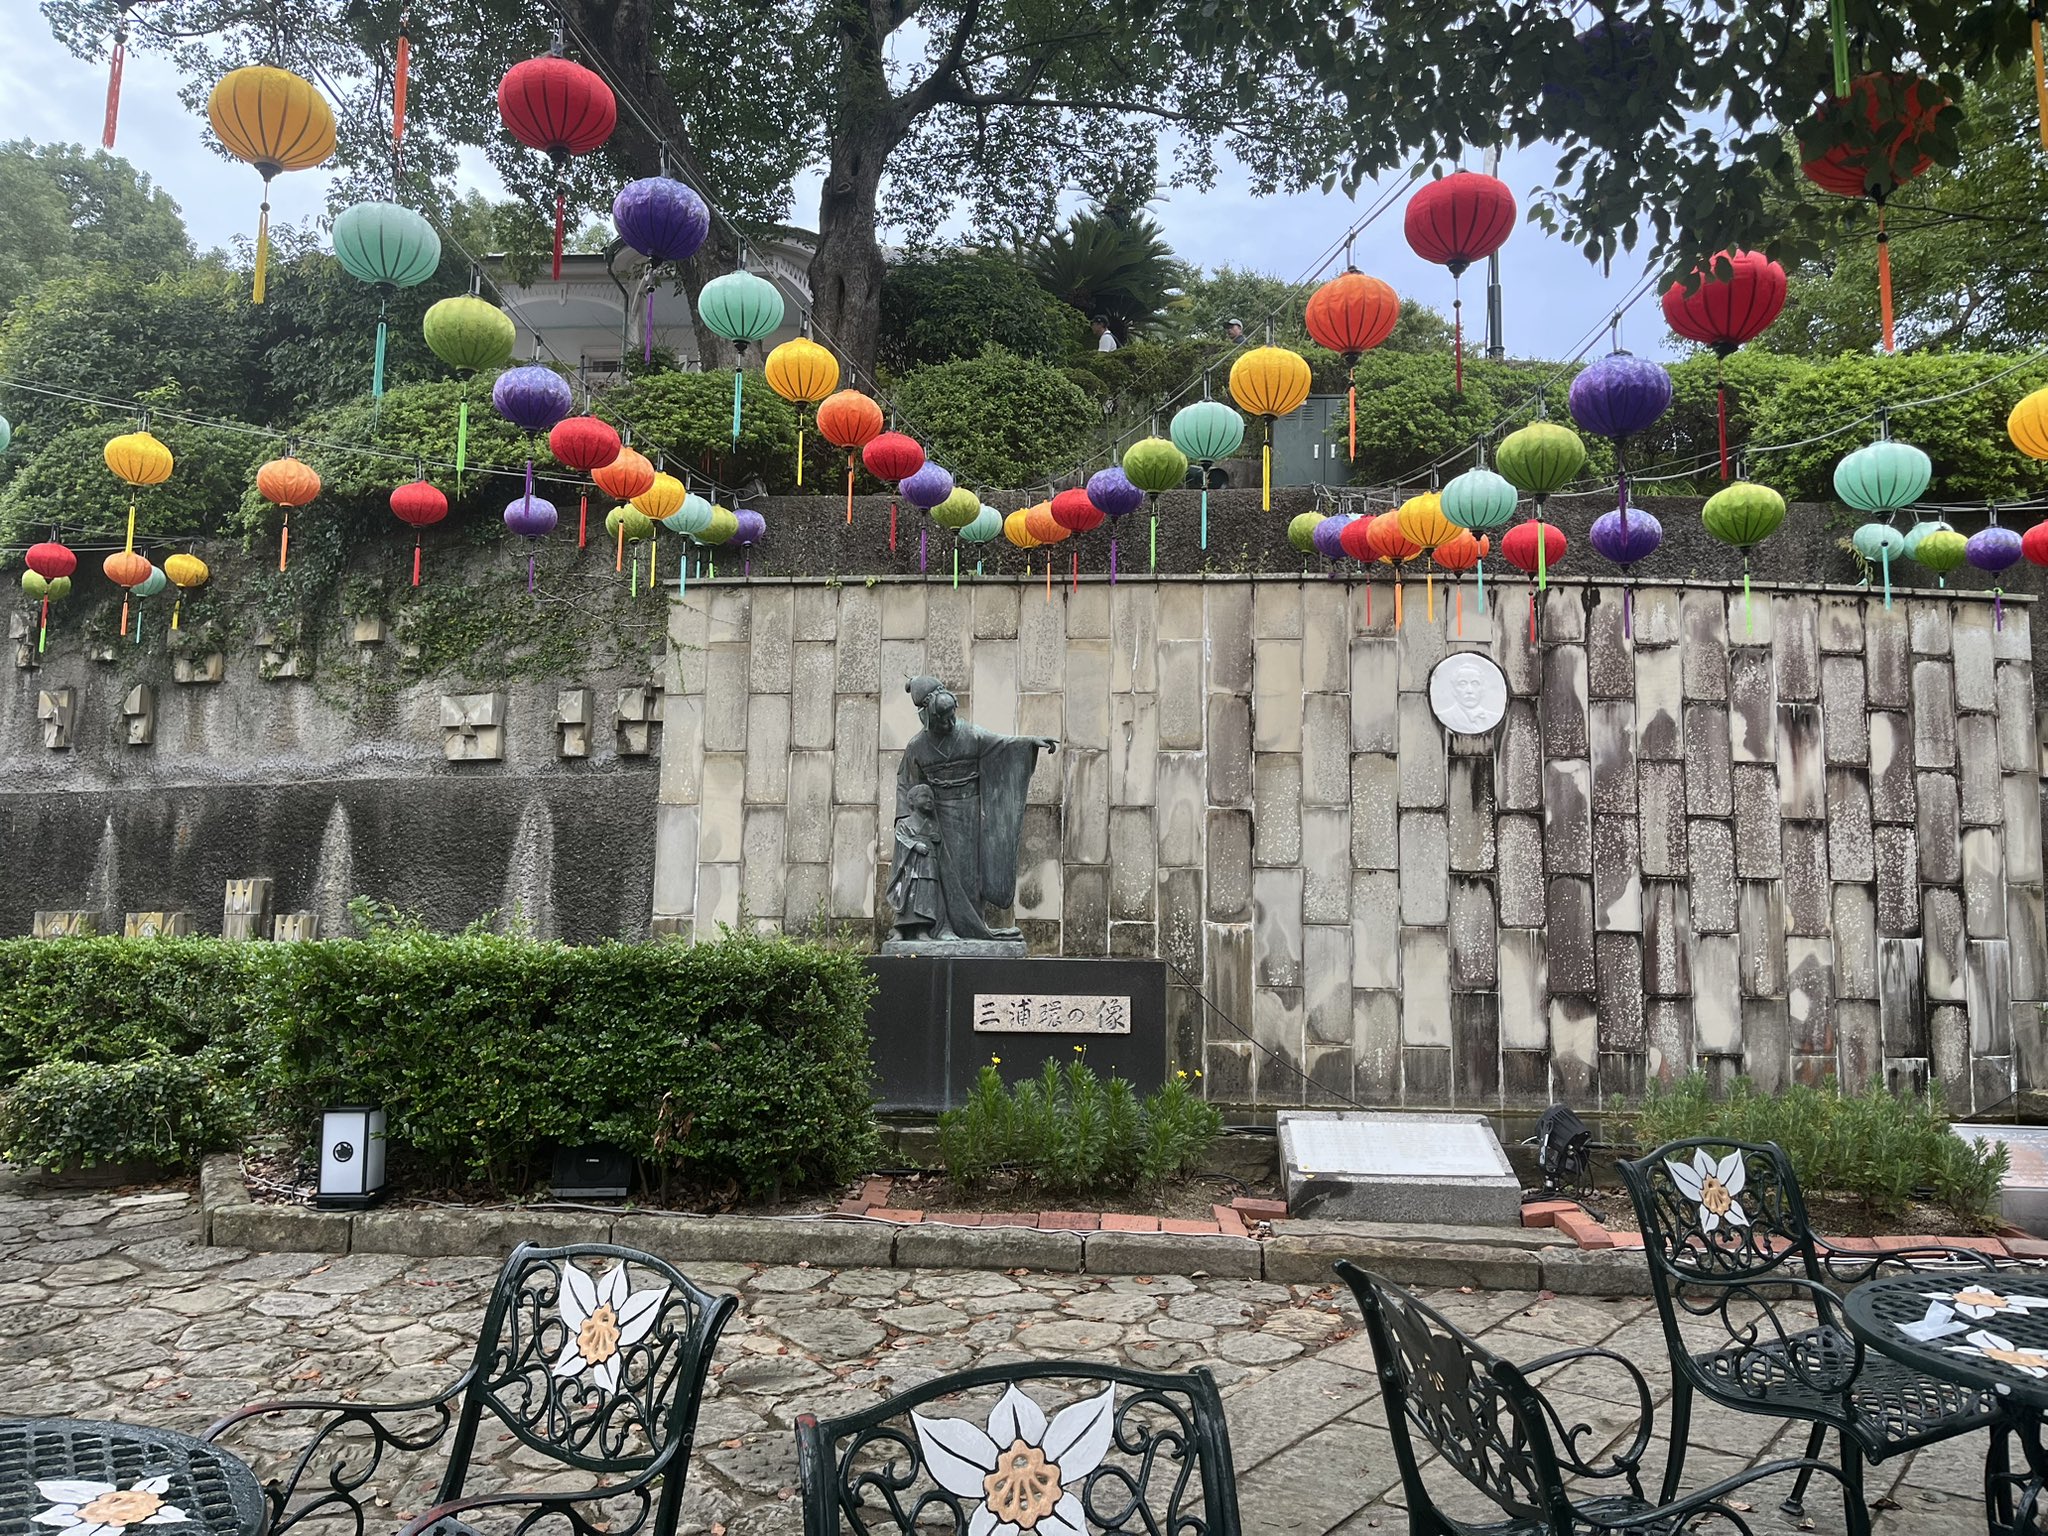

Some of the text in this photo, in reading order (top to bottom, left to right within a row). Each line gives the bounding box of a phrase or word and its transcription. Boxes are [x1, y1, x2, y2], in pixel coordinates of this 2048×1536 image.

[979, 999, 1126, 1030] 三浦環の像
